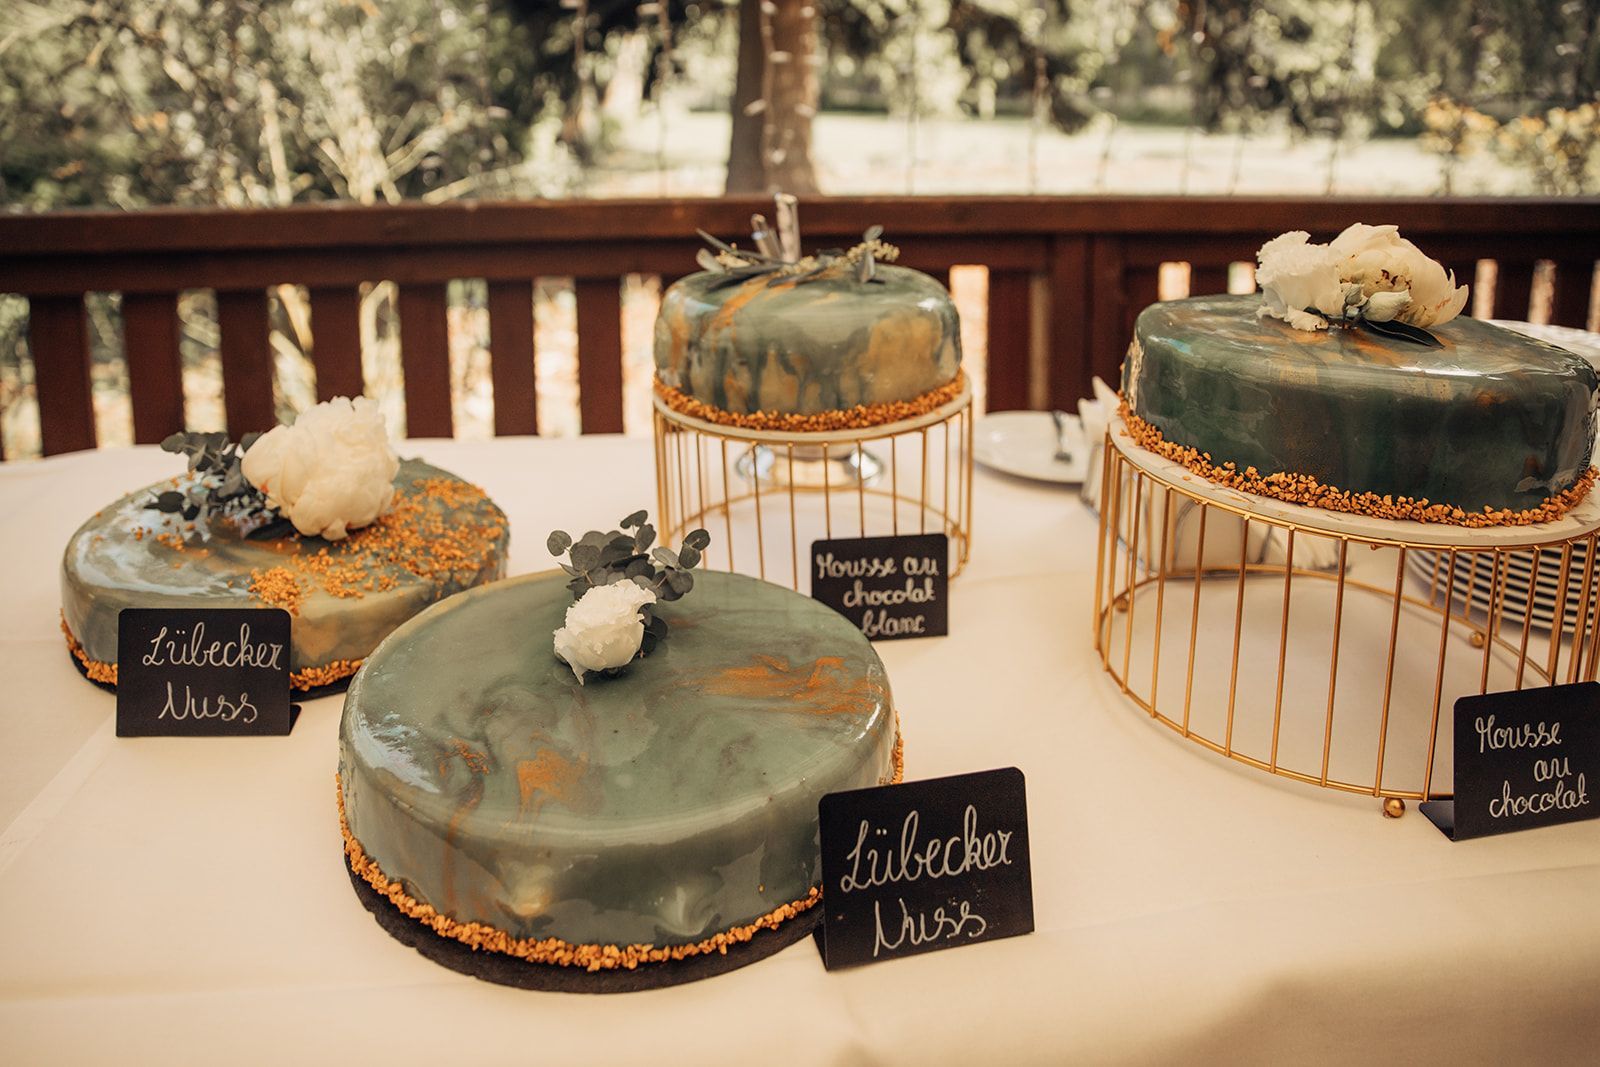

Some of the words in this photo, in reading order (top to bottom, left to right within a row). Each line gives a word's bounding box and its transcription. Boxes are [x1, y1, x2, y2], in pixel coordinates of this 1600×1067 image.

[903, 556, 939, 576] au
[843, 577, 936, 608] chocolat
[862, 609, 925, 636] blanc
[142, 622, 283, 670] Lübecker
[158, 681, 258, 723] Nuss
[1534, 757, 1572, 782] au
[1489, 773, 1590, 818] chocolat
[840, 804, 1013, 893] Lübecker
[873, 898, 987, 957] Nuss
